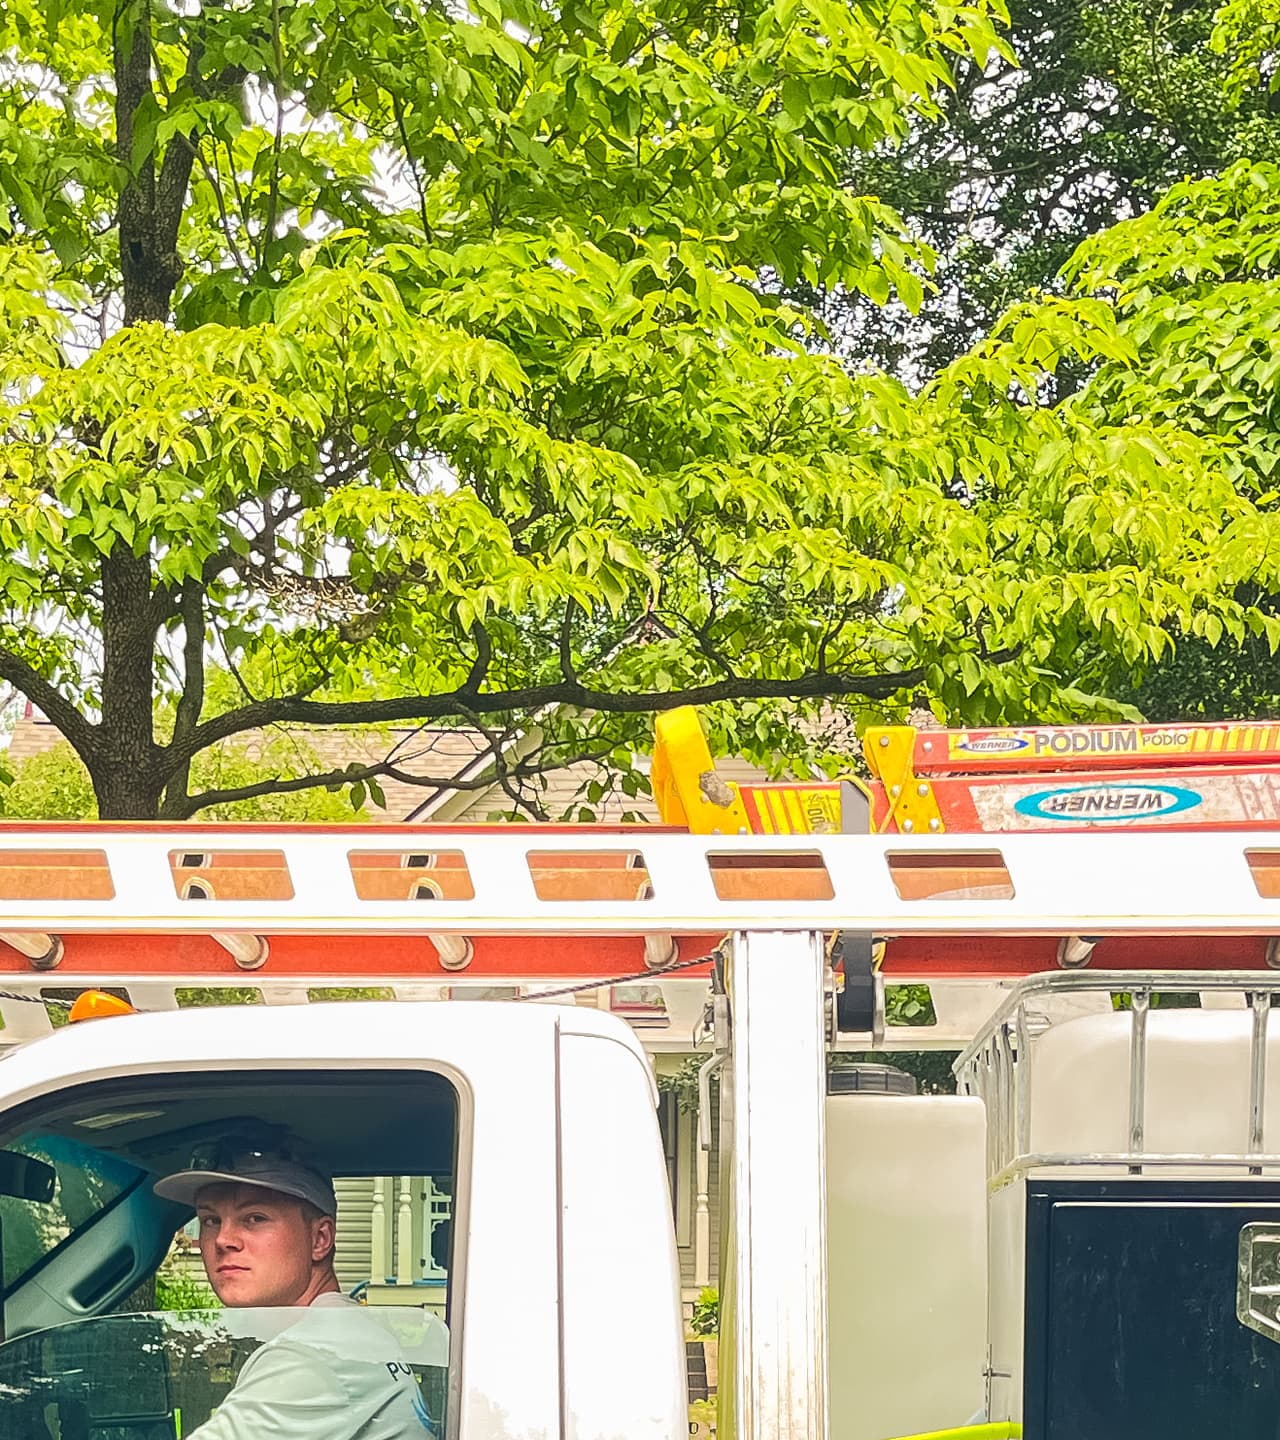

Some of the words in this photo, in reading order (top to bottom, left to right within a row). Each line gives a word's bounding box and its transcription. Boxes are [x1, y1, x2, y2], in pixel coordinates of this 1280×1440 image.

[969, 740, 1017, 750] WERNER
[1034, 731, 1137, 754] PODIUM
[1051, 793, 1163, 812] WERNER
